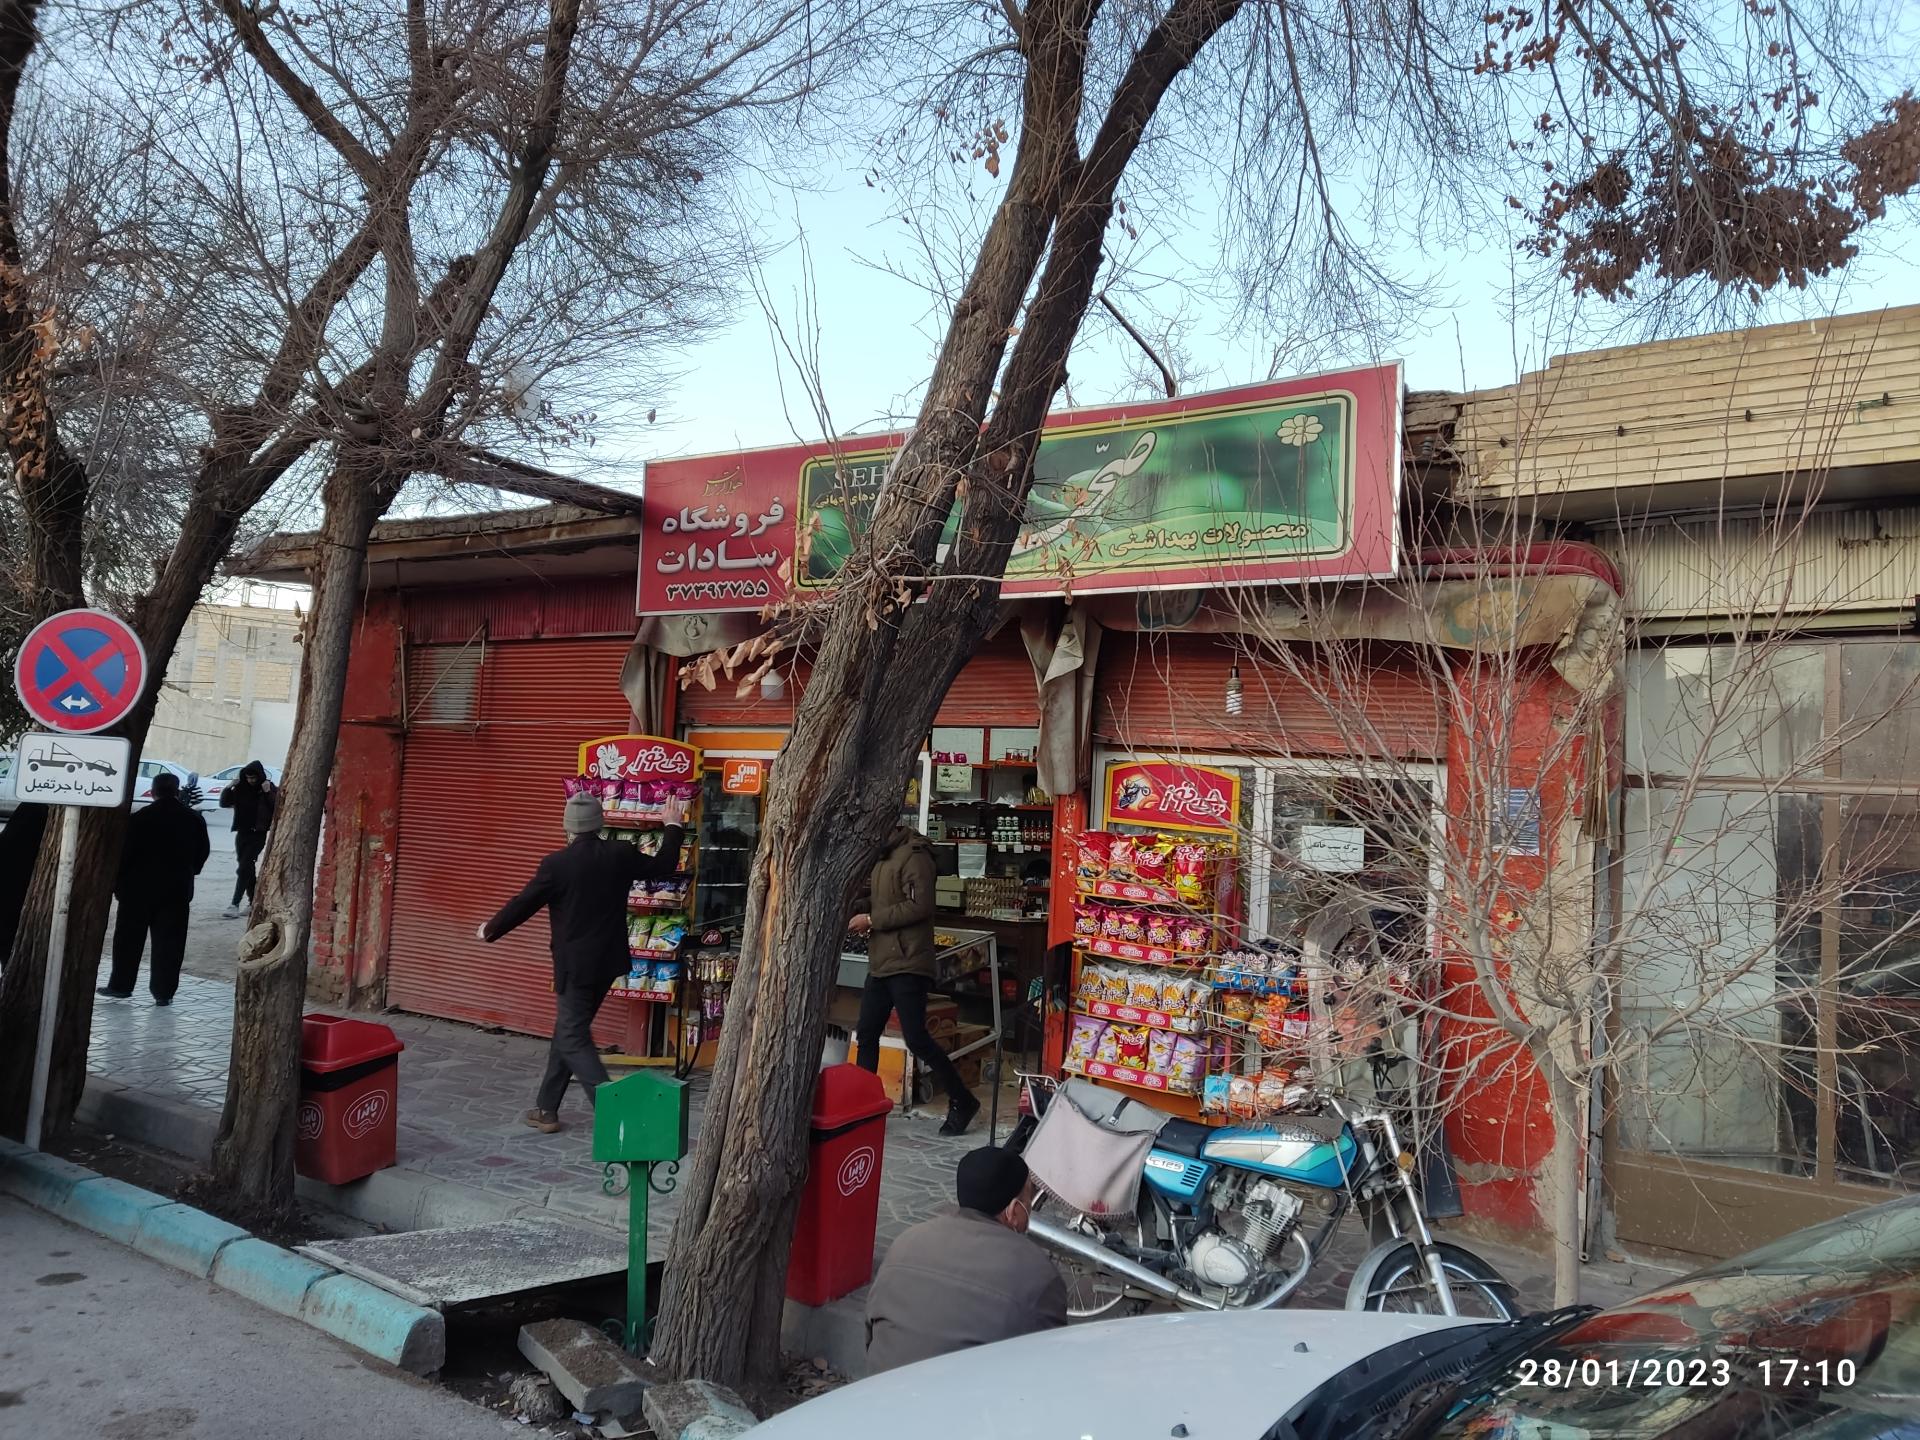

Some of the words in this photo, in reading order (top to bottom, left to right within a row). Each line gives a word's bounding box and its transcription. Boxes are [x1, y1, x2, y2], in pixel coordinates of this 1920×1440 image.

[662, 496, 785, 537] فروشگاه
[1109, 528, 1199, 558] بهداشتی
[1202, 521, 1310, 549] محصولات
[656, 539, 778, 574] سادات
[74, 780, 83, 794] با
[84, 781, 114, 796] حمل
